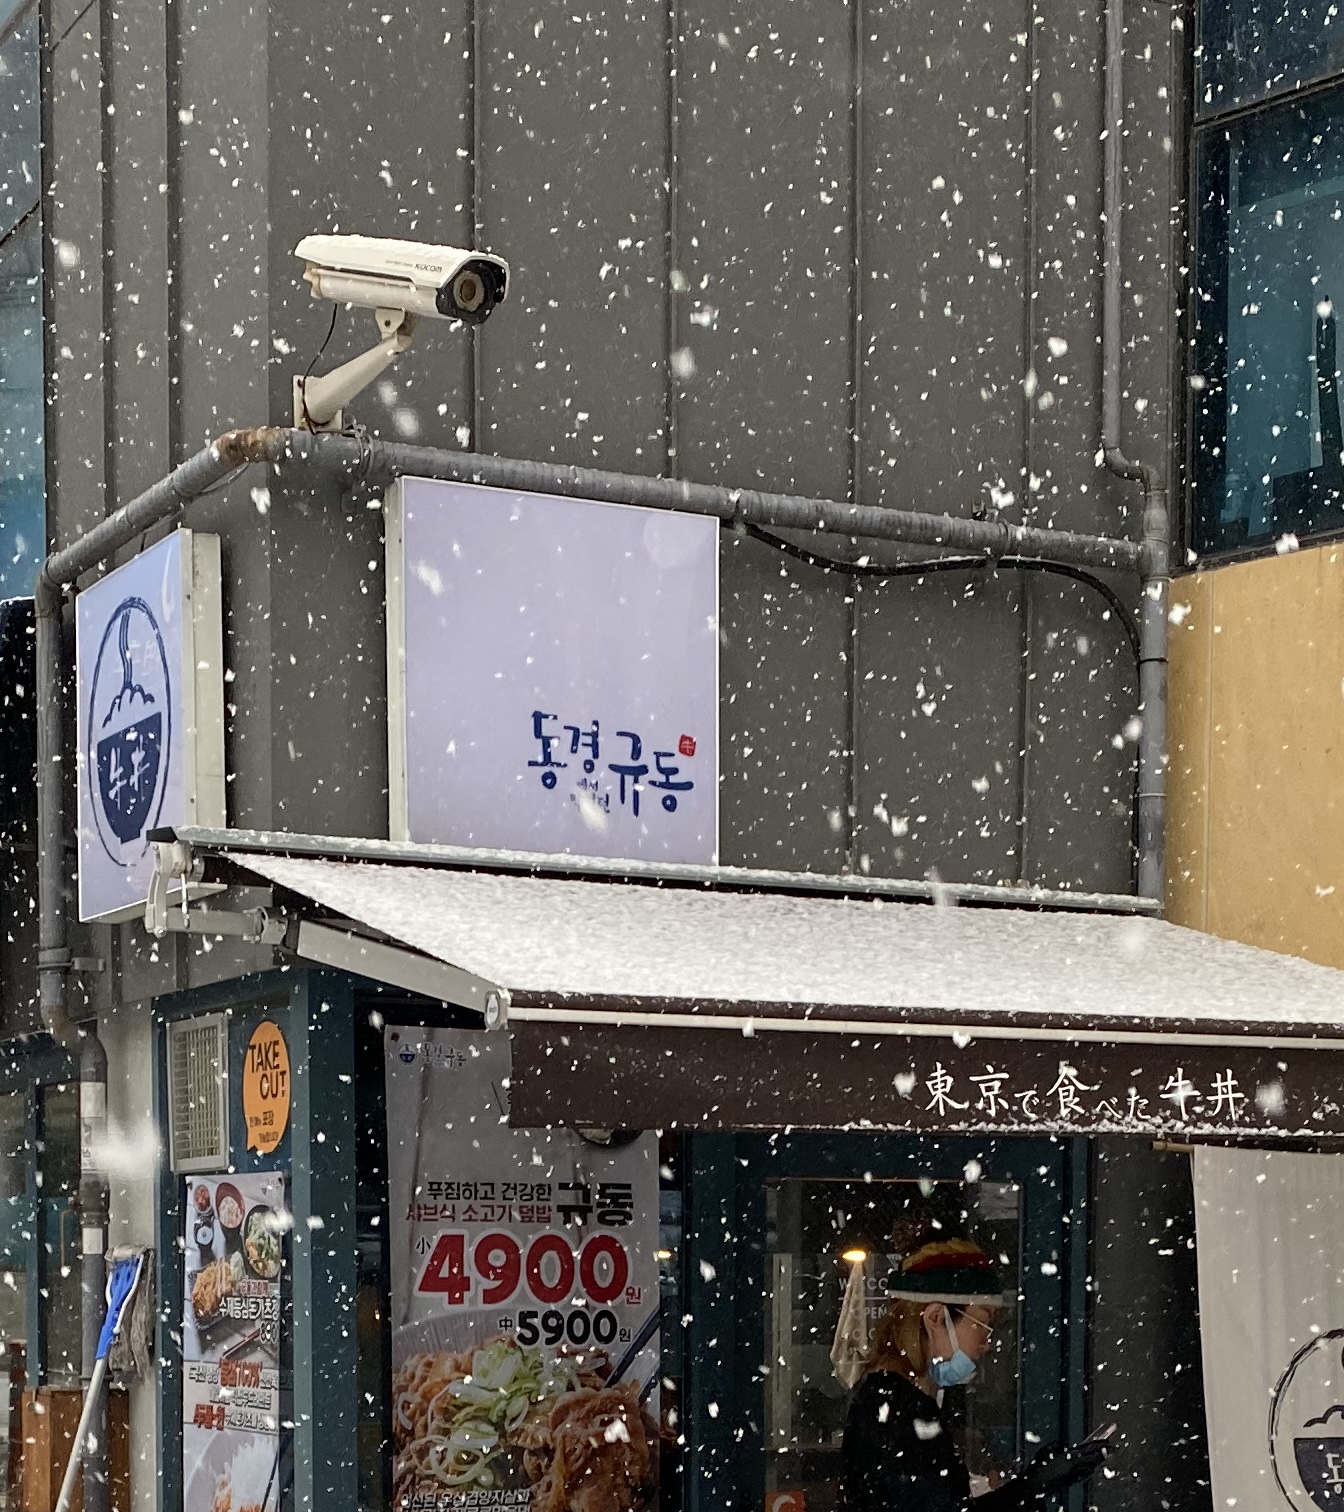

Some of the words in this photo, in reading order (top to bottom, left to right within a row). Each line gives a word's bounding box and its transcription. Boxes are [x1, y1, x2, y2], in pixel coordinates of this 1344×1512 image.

[528, 710, 694, 818] 동경규동
[249, 1040, 280, 1074] TAKE
[260, 1070, 287, 1100] OUT
[427, 1182, 496, 1201] 푸짐하고
[501, 1182, 552, 1200] 건강한
[556, 1182, 634, 1226] 규동
[406, 1203, 456, 1223] 샤브식
[462, 1204, 513, 1223] 소고기
[519, 1204, 552, 1224] 덮밥
